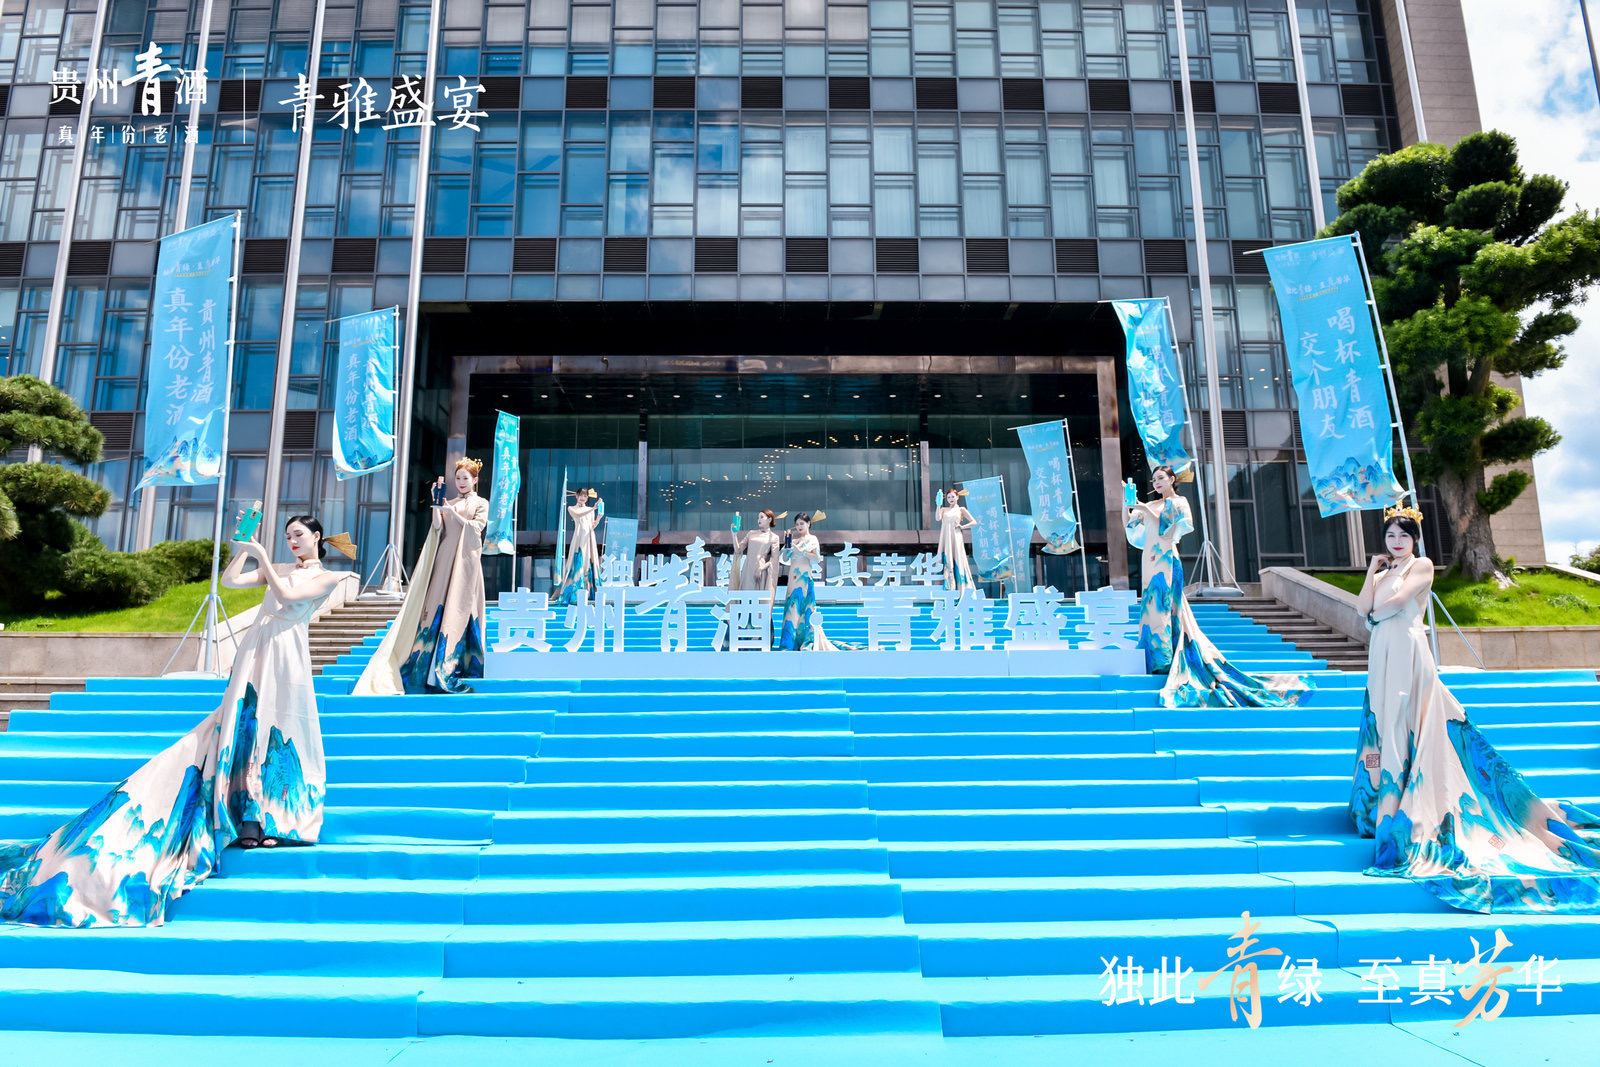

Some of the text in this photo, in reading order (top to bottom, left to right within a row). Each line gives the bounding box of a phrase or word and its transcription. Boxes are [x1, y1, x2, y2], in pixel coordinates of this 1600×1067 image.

[344, 353, 361, 442] 真年份老酒
[1299, 331, 1346, 440] 交个朋友
[1327, 306, 1375, 430] 喝杯青酒
[1035, 467, 1053, 522] 交个朋友
